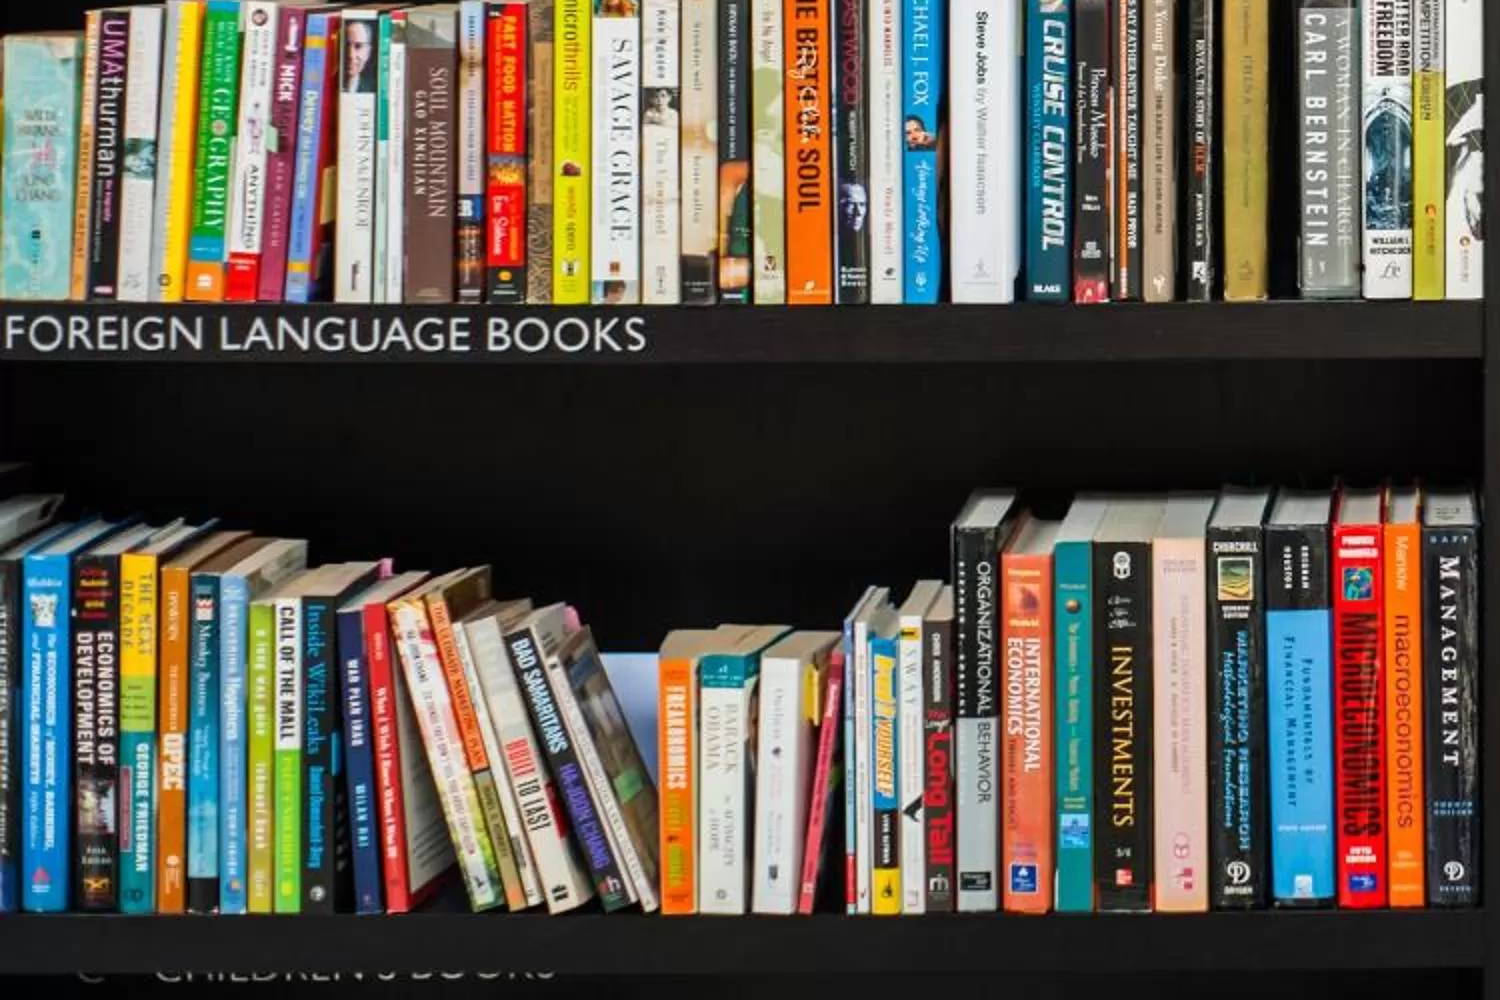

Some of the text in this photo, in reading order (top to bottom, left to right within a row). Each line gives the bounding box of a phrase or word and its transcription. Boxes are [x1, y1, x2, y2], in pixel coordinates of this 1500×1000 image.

[277, 63, 296, 102] MICK
[499, 15, 517, 153] FAST FOOD NATION
[913, 72, 928, 106] FOX
[1152, 10, 1167, 52] Young
[1152, 57, 1167, 90] Duke
[1375, 1, 1394, 76] FREEDOM
[96, 19, 127, 179] UMAthurman
[428, 67, 448, 218] SOUL MOUNTAIN
[609, 38, 633, 243] SAVAGE GRACE
[1042, 19, 1067, 252] CRUISE CONTROL
[1304, 13, 1330, 248] CARL BERNSTEIN
[5, 315, 646, 351] FOREIGN LANGUAGE BOOKS
[1213, 542, 1258, 552] CHURCHILL
[1430, 535, 1469, 544] DAFT
[77, 632, 94, 765] DEVELOPMENT
[98, 631, 115, 767] ECONOMICS OF
[281, 607, 296, 740] CALL OF THE MALL
[307, 605, 325, 754] Inside WikiLeaks
[348, 659, 363, 747] WAR PLAN IRAQ
[511, 638, 569, 753] BAD SAMARITANS
[976, 561, 992, 803] ORGANIZATIONAL BEHAVIOR
[1007, 638, 1023, 737] ECONOMICS
[1024, 638, 1041, 772] INTERNATIONAL
[1283, 636, 1297, 807] FINANCIAL MANAGEMENT
[1302, 659, 1314, 760] FUNDAMENTALS
[1342, 612, 1381, 837] MICROECONOMICS
[1395, 536, 1413, 829] Mankiw macroeconomics
[1439, 555, 1461, 767] MANAGEMENT
[162, 732, 185, 791] OPEC
[506, 737, 551, 833] BUILT TO LAST
[666, 686, 688, 790] FREAKONOMICS
[706, 706, 721, 771] OBAMA
[724, 703, 738, 774] BARACK
[927, 733, 952, 864] Long Tail
[1113, 646, 1134, 827] INVESTMENTS
[135, 743, 149, 872] GEORGE FRIEDMAN
[356, 784, 369, 847] MILAN RAI
